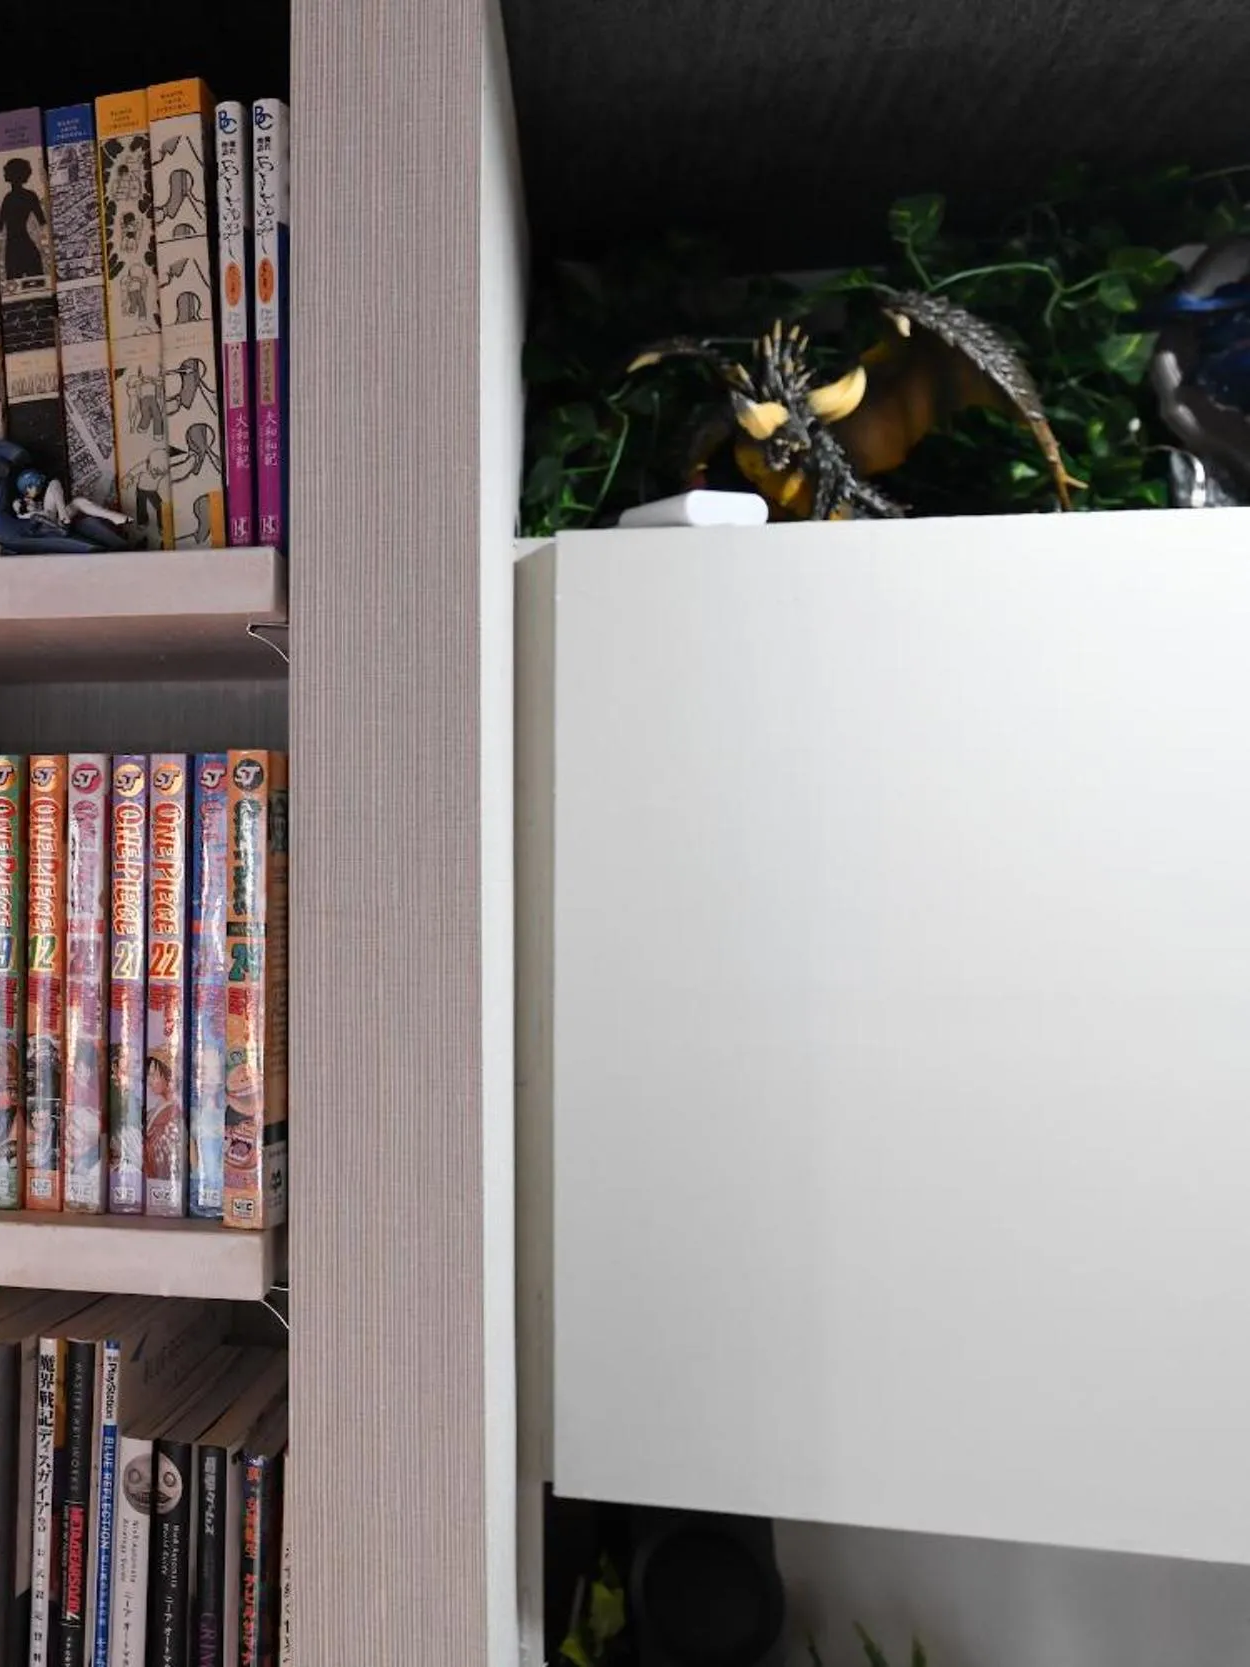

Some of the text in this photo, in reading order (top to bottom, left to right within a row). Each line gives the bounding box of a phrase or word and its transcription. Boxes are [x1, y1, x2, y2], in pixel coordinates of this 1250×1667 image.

[236, 413, 249, 468] 大和和紀
[264, 411, 277, 466] 大和和紀
[30, 797, 60, 855] ONE
[114, 801, 144, 858] ONE
[153, 801, 183, 858] ONE
[29, 856, 60, 929] PIECE
[114, 859, 144, 936] PIECE
[152, 859, 183, 936] PIECE
[30, 935, 56, 970] 12
[112, 941, 143, 978] 21
[149, 941, 182, 978] 22
[106, 1363, 117, 1419] PlayStation
[102, 1436, 114, 1468] BLUE
[99, 1472, 112, 1550] REFLECTION
